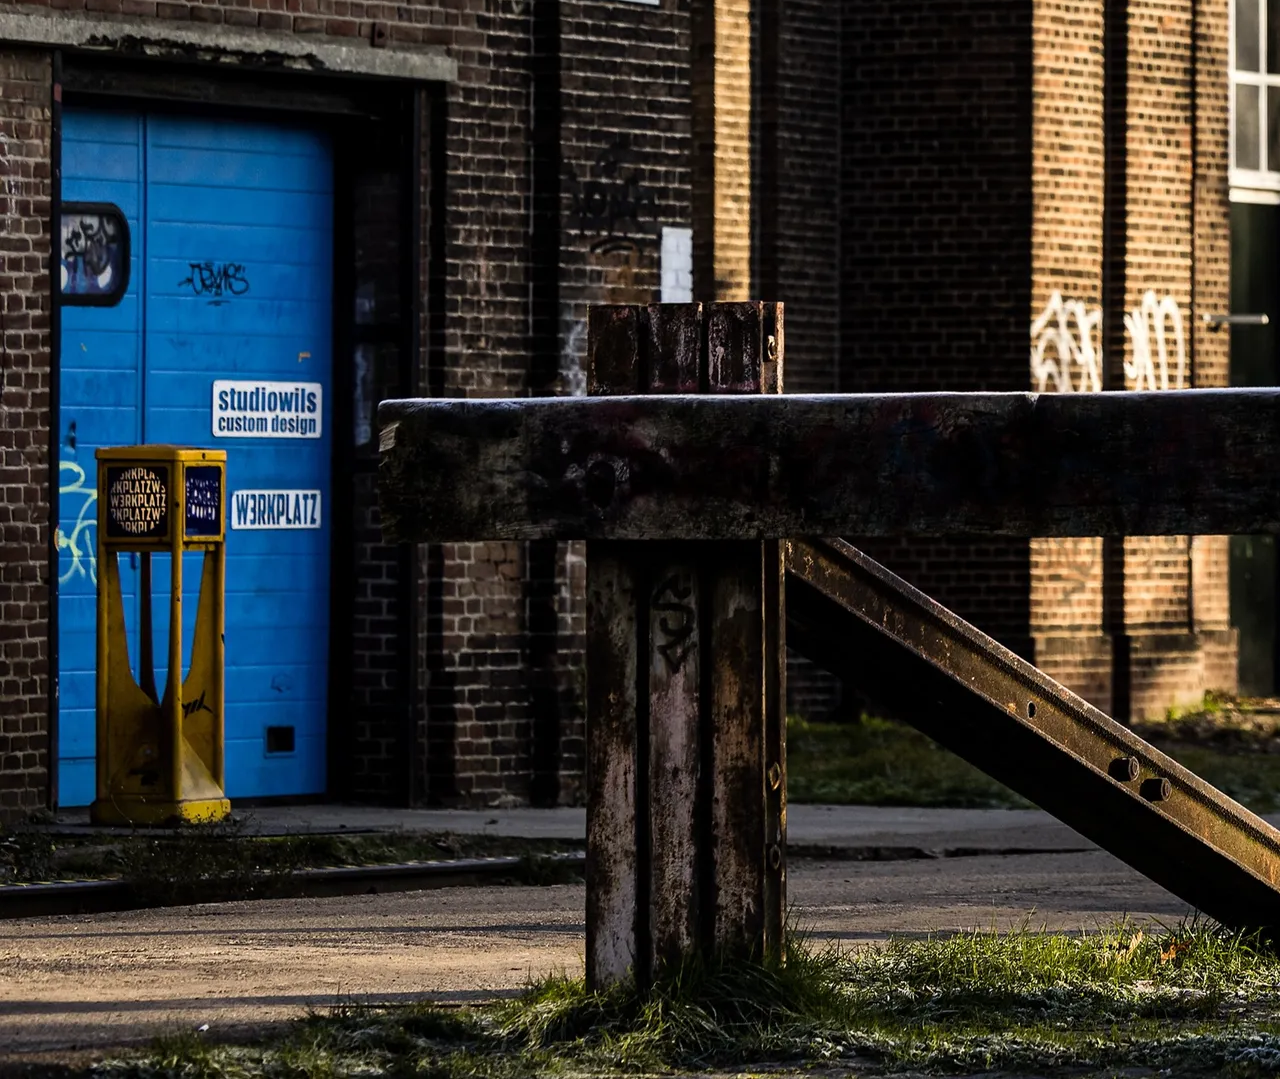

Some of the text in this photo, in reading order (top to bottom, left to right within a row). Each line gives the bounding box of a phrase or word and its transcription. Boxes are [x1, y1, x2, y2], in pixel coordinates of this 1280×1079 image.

[218, 387, 317, 414] studiowils
[218, 415, 316, 435] custom design
[235, 493, 318, 526] W3RKPLATZ
